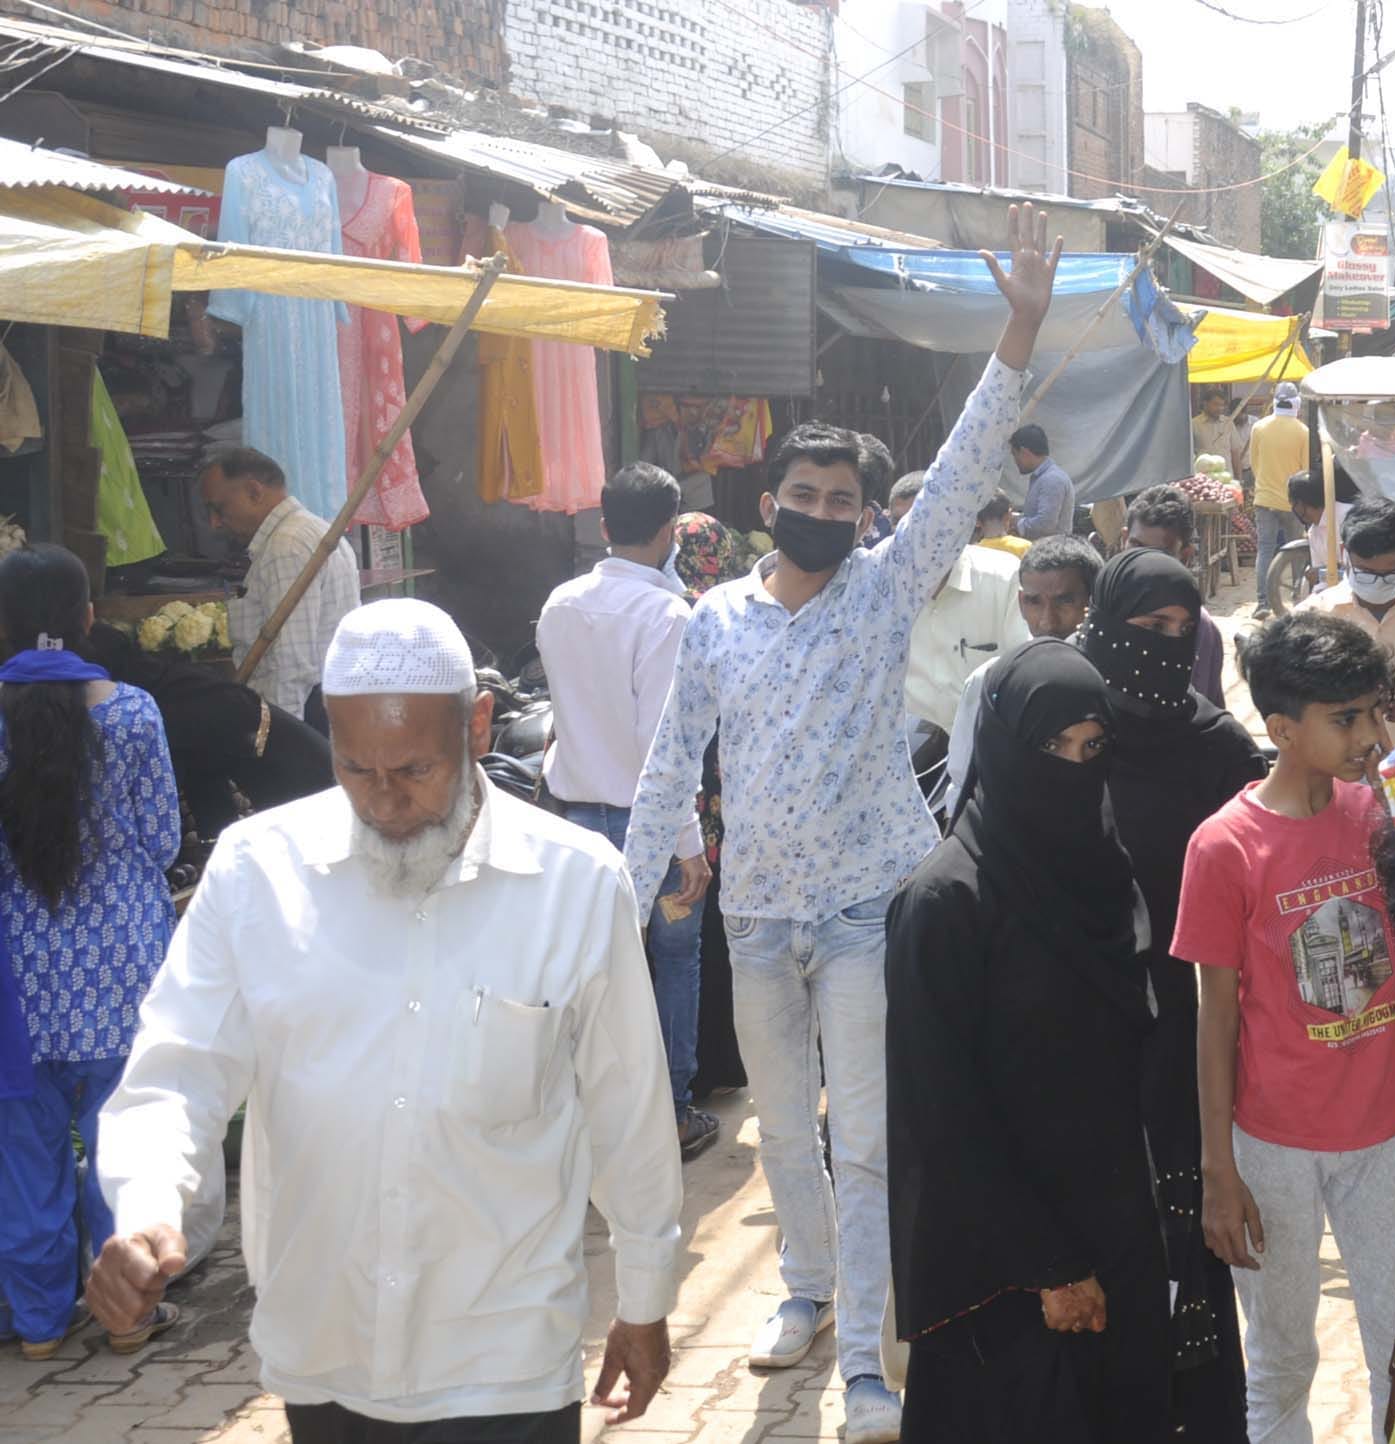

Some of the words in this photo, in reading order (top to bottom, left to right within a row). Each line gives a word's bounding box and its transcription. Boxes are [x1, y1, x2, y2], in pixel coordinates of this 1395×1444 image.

[1337, 260, 1376, 273] Glossy
[1328, 271, 1385, 282] Makeover
[1281, 873, 1375, 910] ENGLAND
[1311, 1026, 1331, 1039] THE
